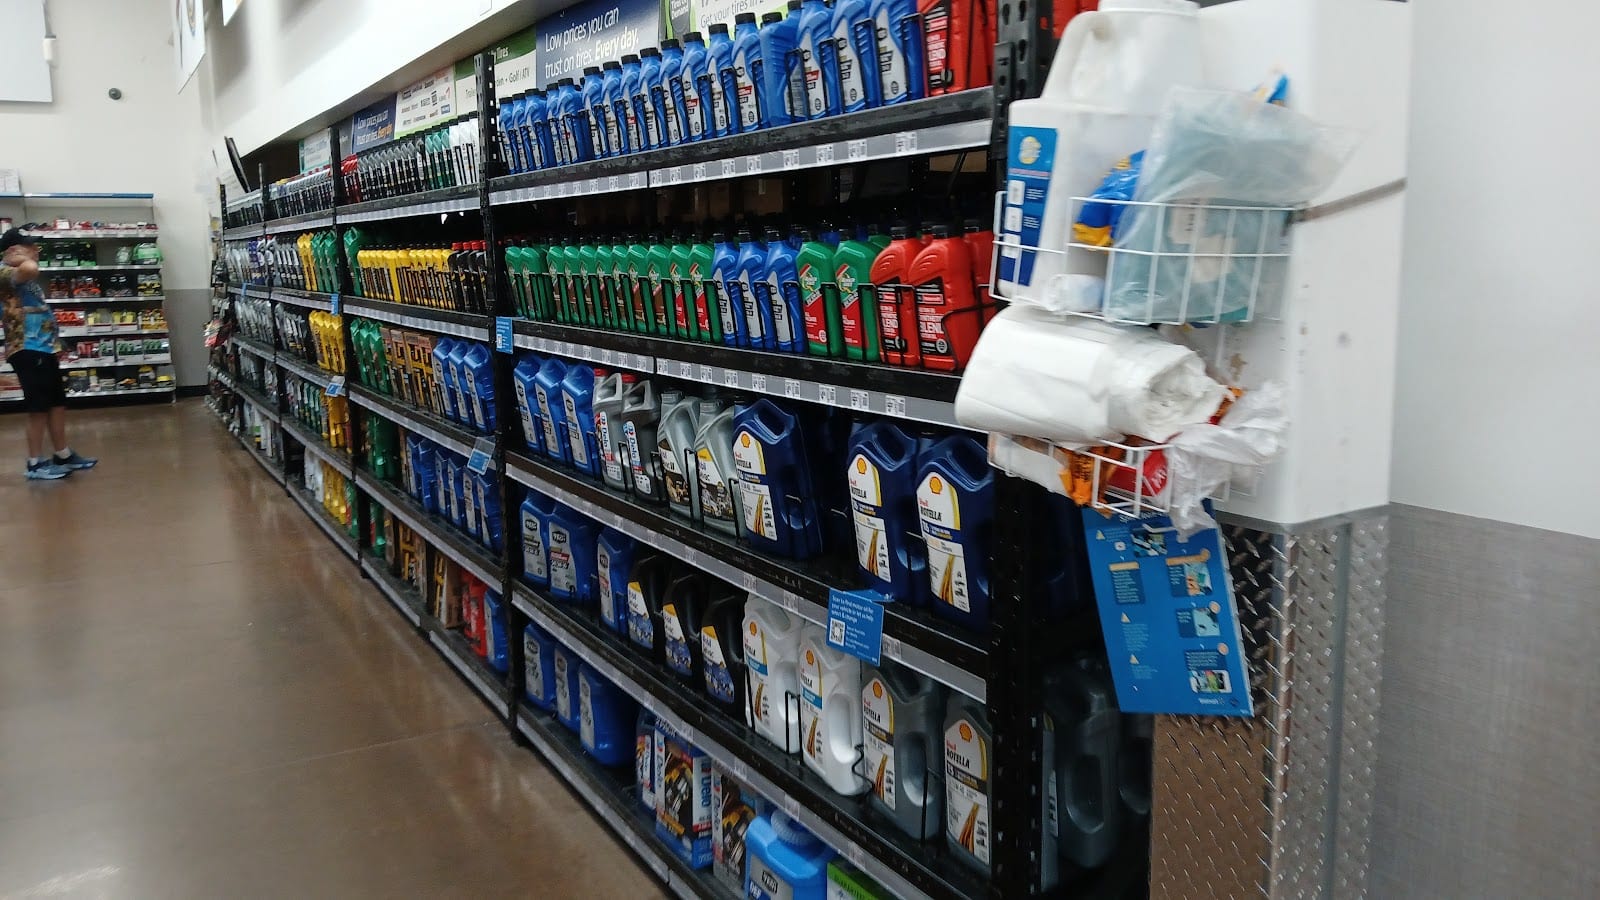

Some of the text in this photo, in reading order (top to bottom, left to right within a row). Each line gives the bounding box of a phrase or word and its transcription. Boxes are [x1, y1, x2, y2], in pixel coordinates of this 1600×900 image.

[545, 7, 619, 52] Low prices you can
[700, 13, 712, 29] Get
[713, 6, 730, 24] your
[731, 0, 748, 15] tires
[545, 26, 639, 79] trust on tires. Every day.
[946, 748, 970, 769] ROTELLA
